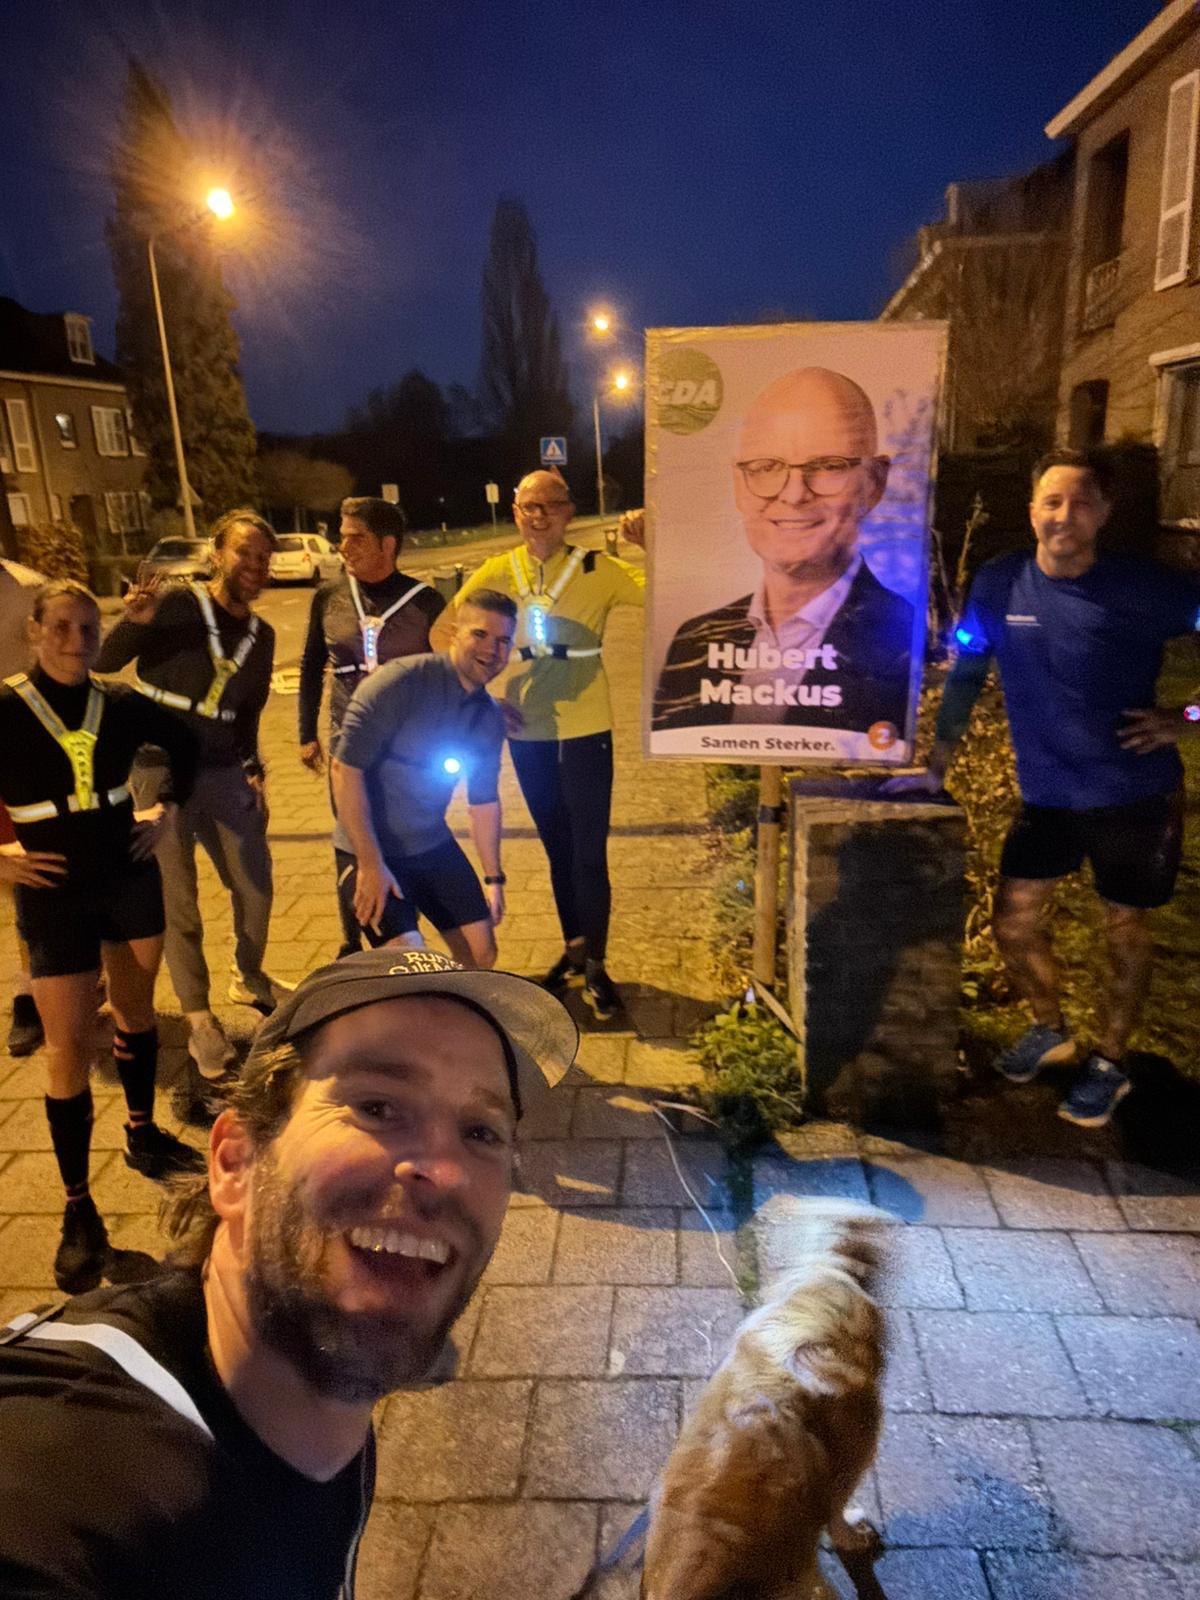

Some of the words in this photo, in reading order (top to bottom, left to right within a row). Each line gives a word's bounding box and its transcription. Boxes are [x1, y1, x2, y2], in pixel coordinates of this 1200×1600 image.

[654, 379, 719, 405] CDA
[707, 642, 838, 670] Hubert
[700, 678, 843, 706] Mackus
[701, 736, 759, 750] Samen
[764, 738, 836, 752] Sterker.
[878, 728, 891, 745] 2
